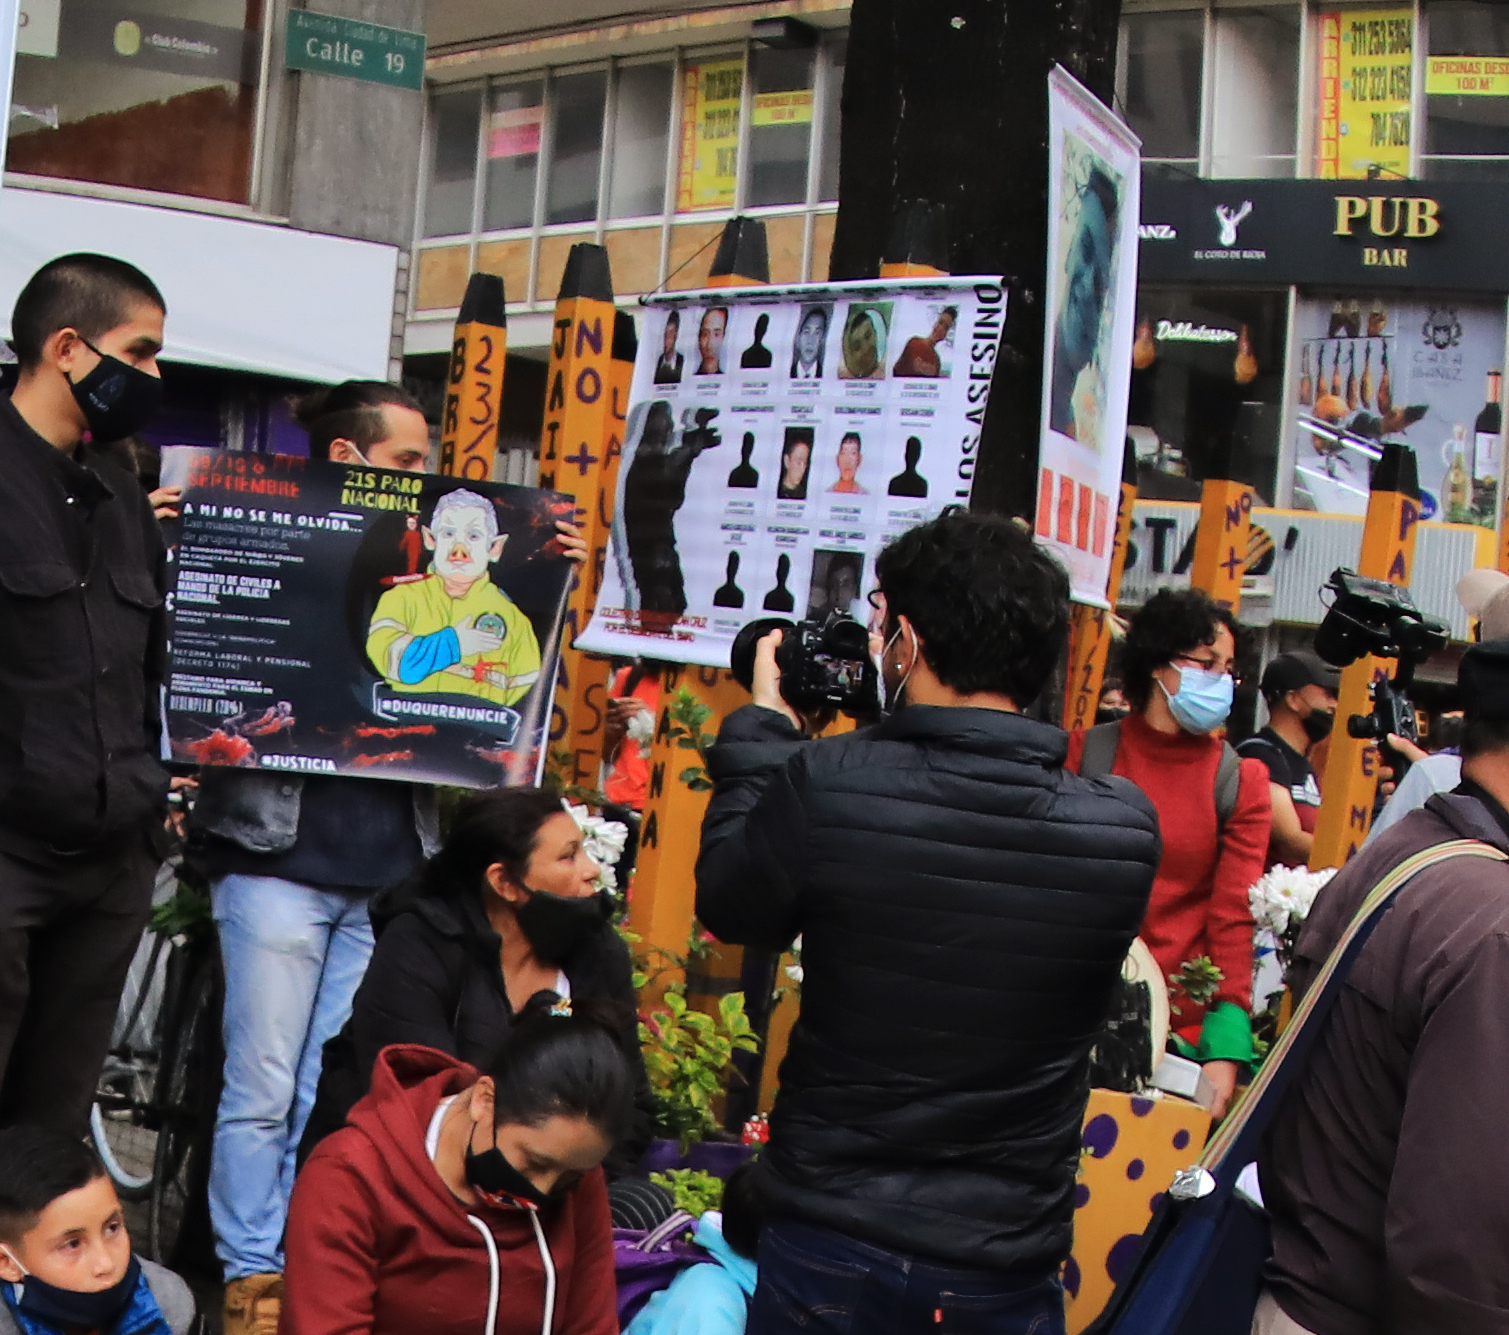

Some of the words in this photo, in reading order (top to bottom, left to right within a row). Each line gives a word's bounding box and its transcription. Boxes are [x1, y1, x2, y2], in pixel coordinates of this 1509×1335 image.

[305, 37, 364, 66] Calle
[385, 52, 406, 73] 19
[1332, 195, 1442, 238] PUB
[1362, 248, 1409, 267] BAR
[343, 470, 377, 489] 21S
[381, 476, 424, 495] PARO
[340, 487, 422, 514] NACIONAL
[184, 502, 194, 515] A
[200, 504, 217, 517] MI
[222, 507, 244, 520] NO
[249, 509, 267, 522] SE
[272, 512, 292, 525] ME
[197, 534, 238, 546] grupos
[260, 527, 279, 537] por
[281, 527, 311, 541] parte
[177, 580, 207, 593] MANOS
[208, 583, 220, 594] DE
[222, 585, 235, 595] LA
[178, 570, 225, 584] ASESINATO
[226, 575, 238, 585] DE
[239, 576, 273, 589] CIVILES
[273, 579, 282, 590] A
[215, 652, 253, 663] LABORAL
[264, 657, 311, 668] PENSIONAL
[382, 697, 509, 725] #DUQUERENUNCIE
[260, 753, 338, 772] #JUSTICIA
